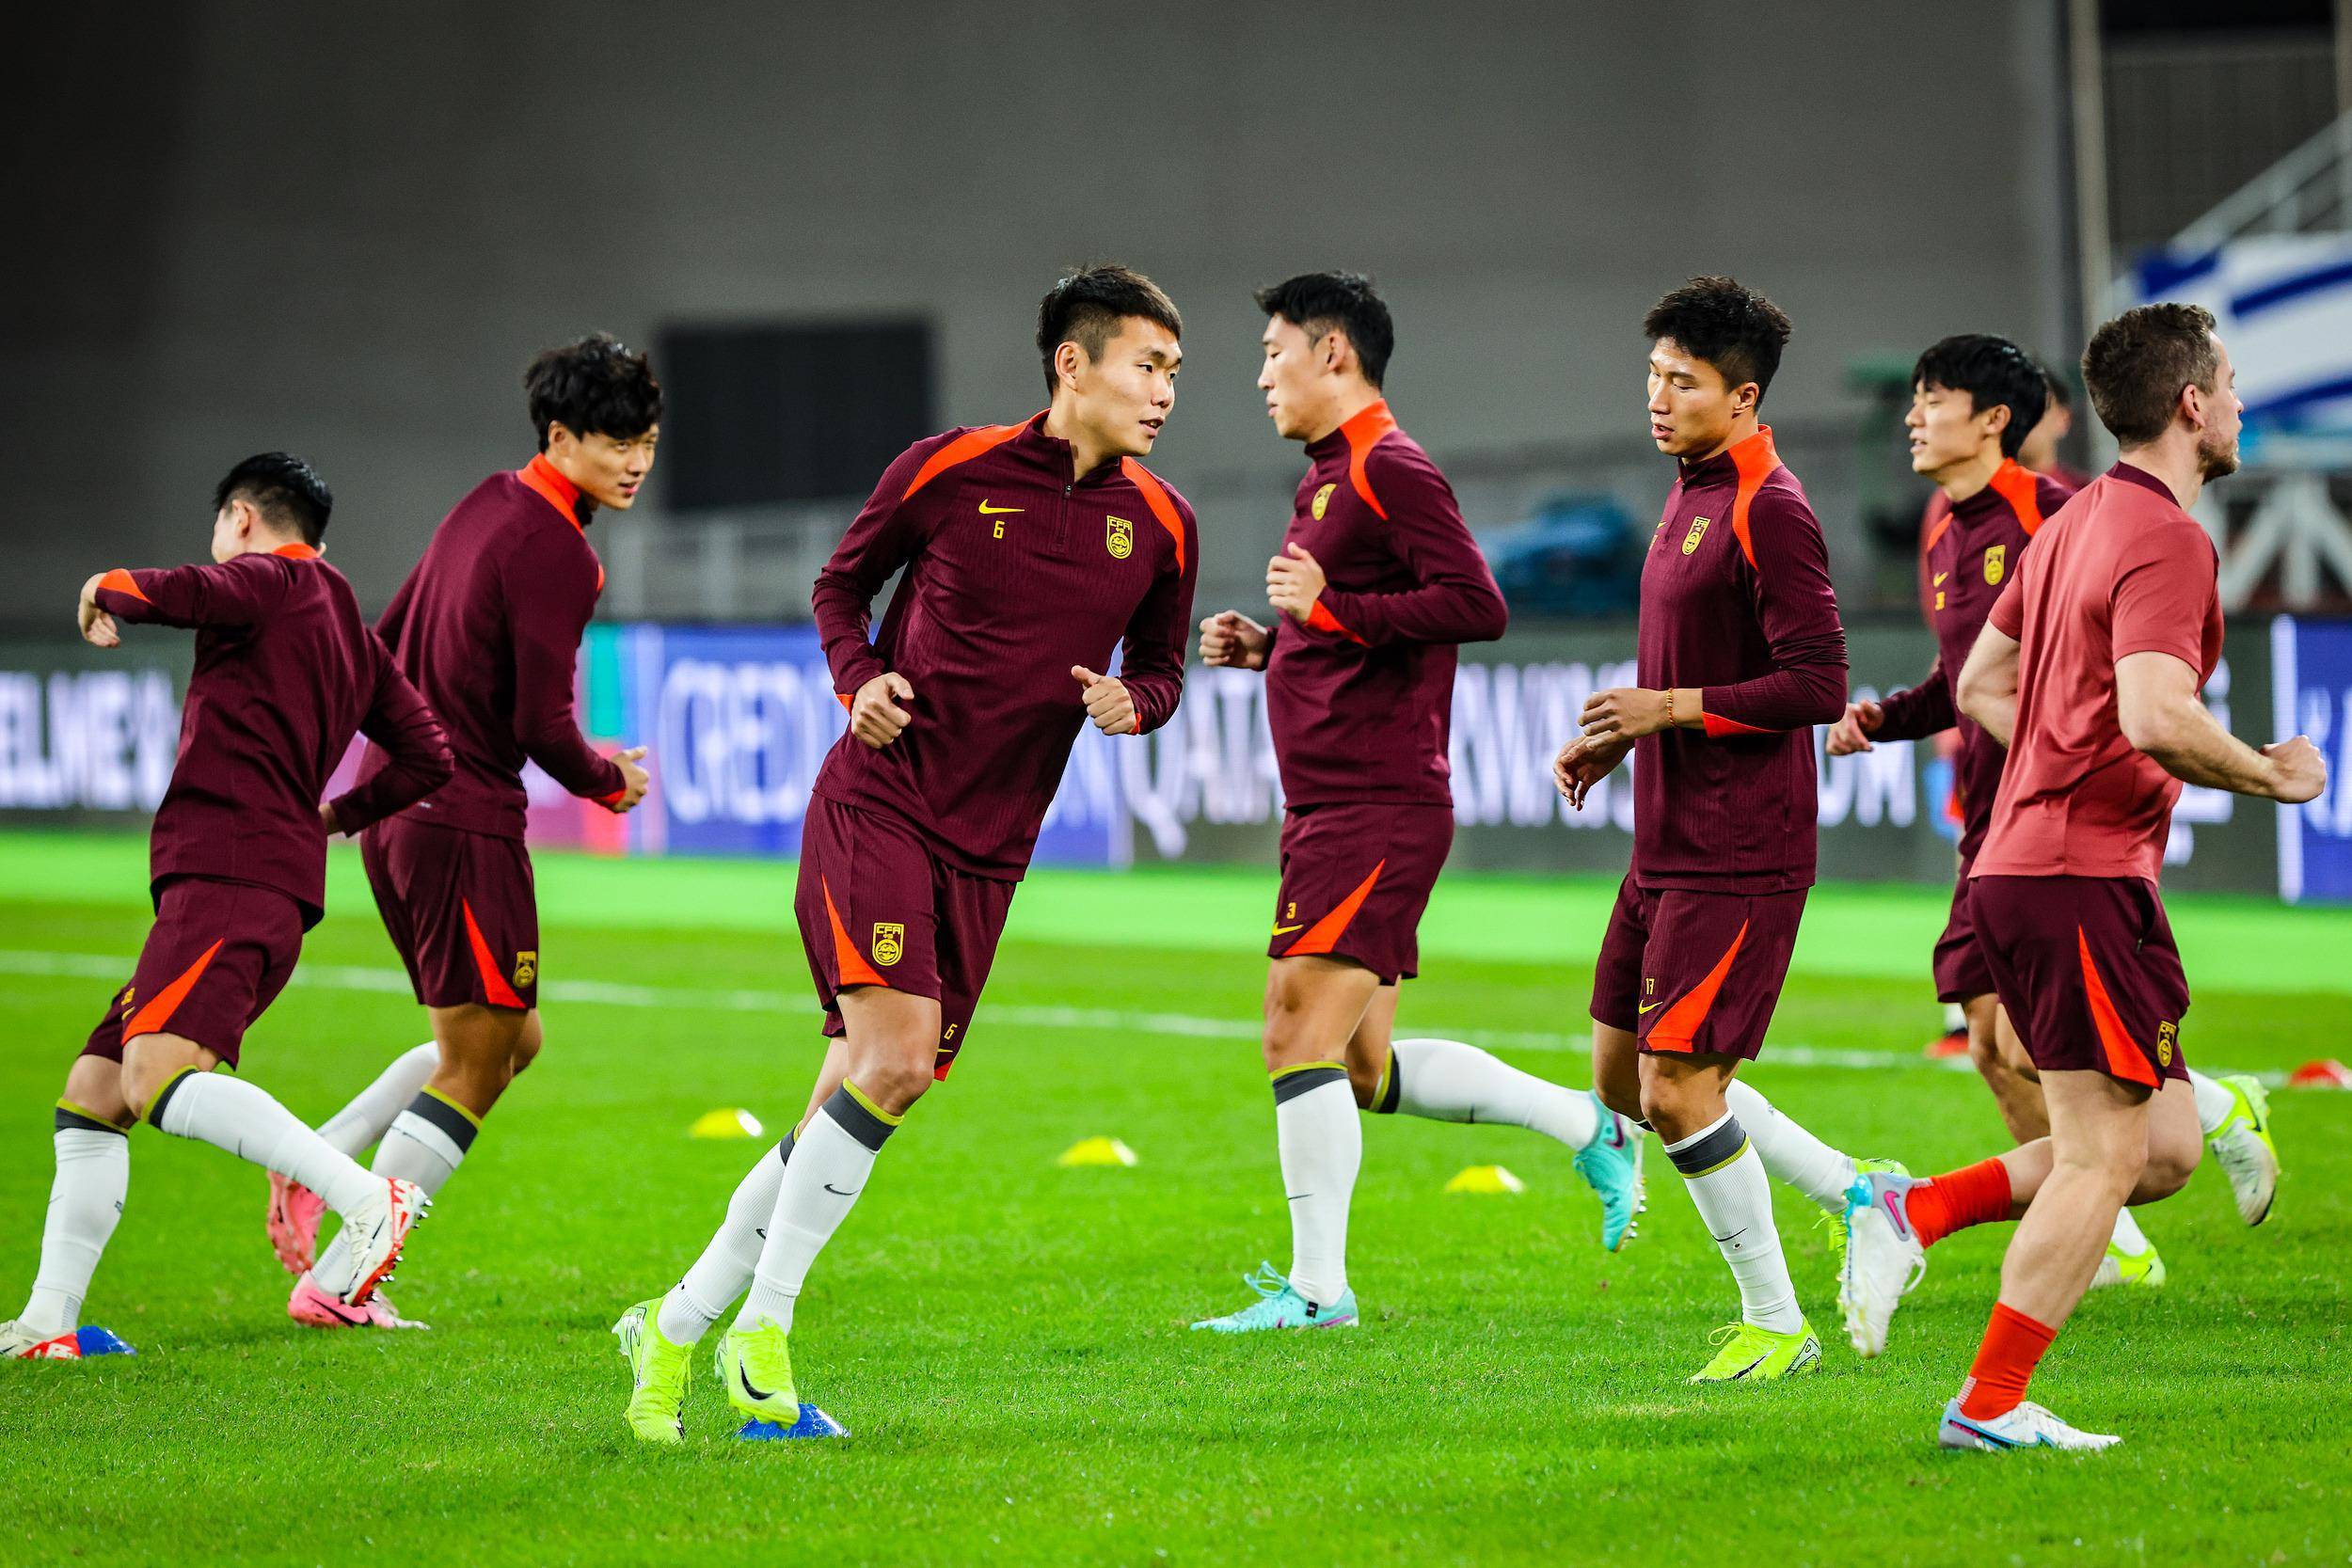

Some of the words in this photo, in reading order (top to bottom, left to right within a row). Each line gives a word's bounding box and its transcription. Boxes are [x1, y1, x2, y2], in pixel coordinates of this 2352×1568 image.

[993, 520, 1005, 539] 6
[1109, 517, 1131, 531] CFA
[1286, 902, 1296, 919] 3
[876, 925, 901, 935] CFA
[1645, 978, 1655, 995] 17
[944, 1023, 958, 1040] 6
